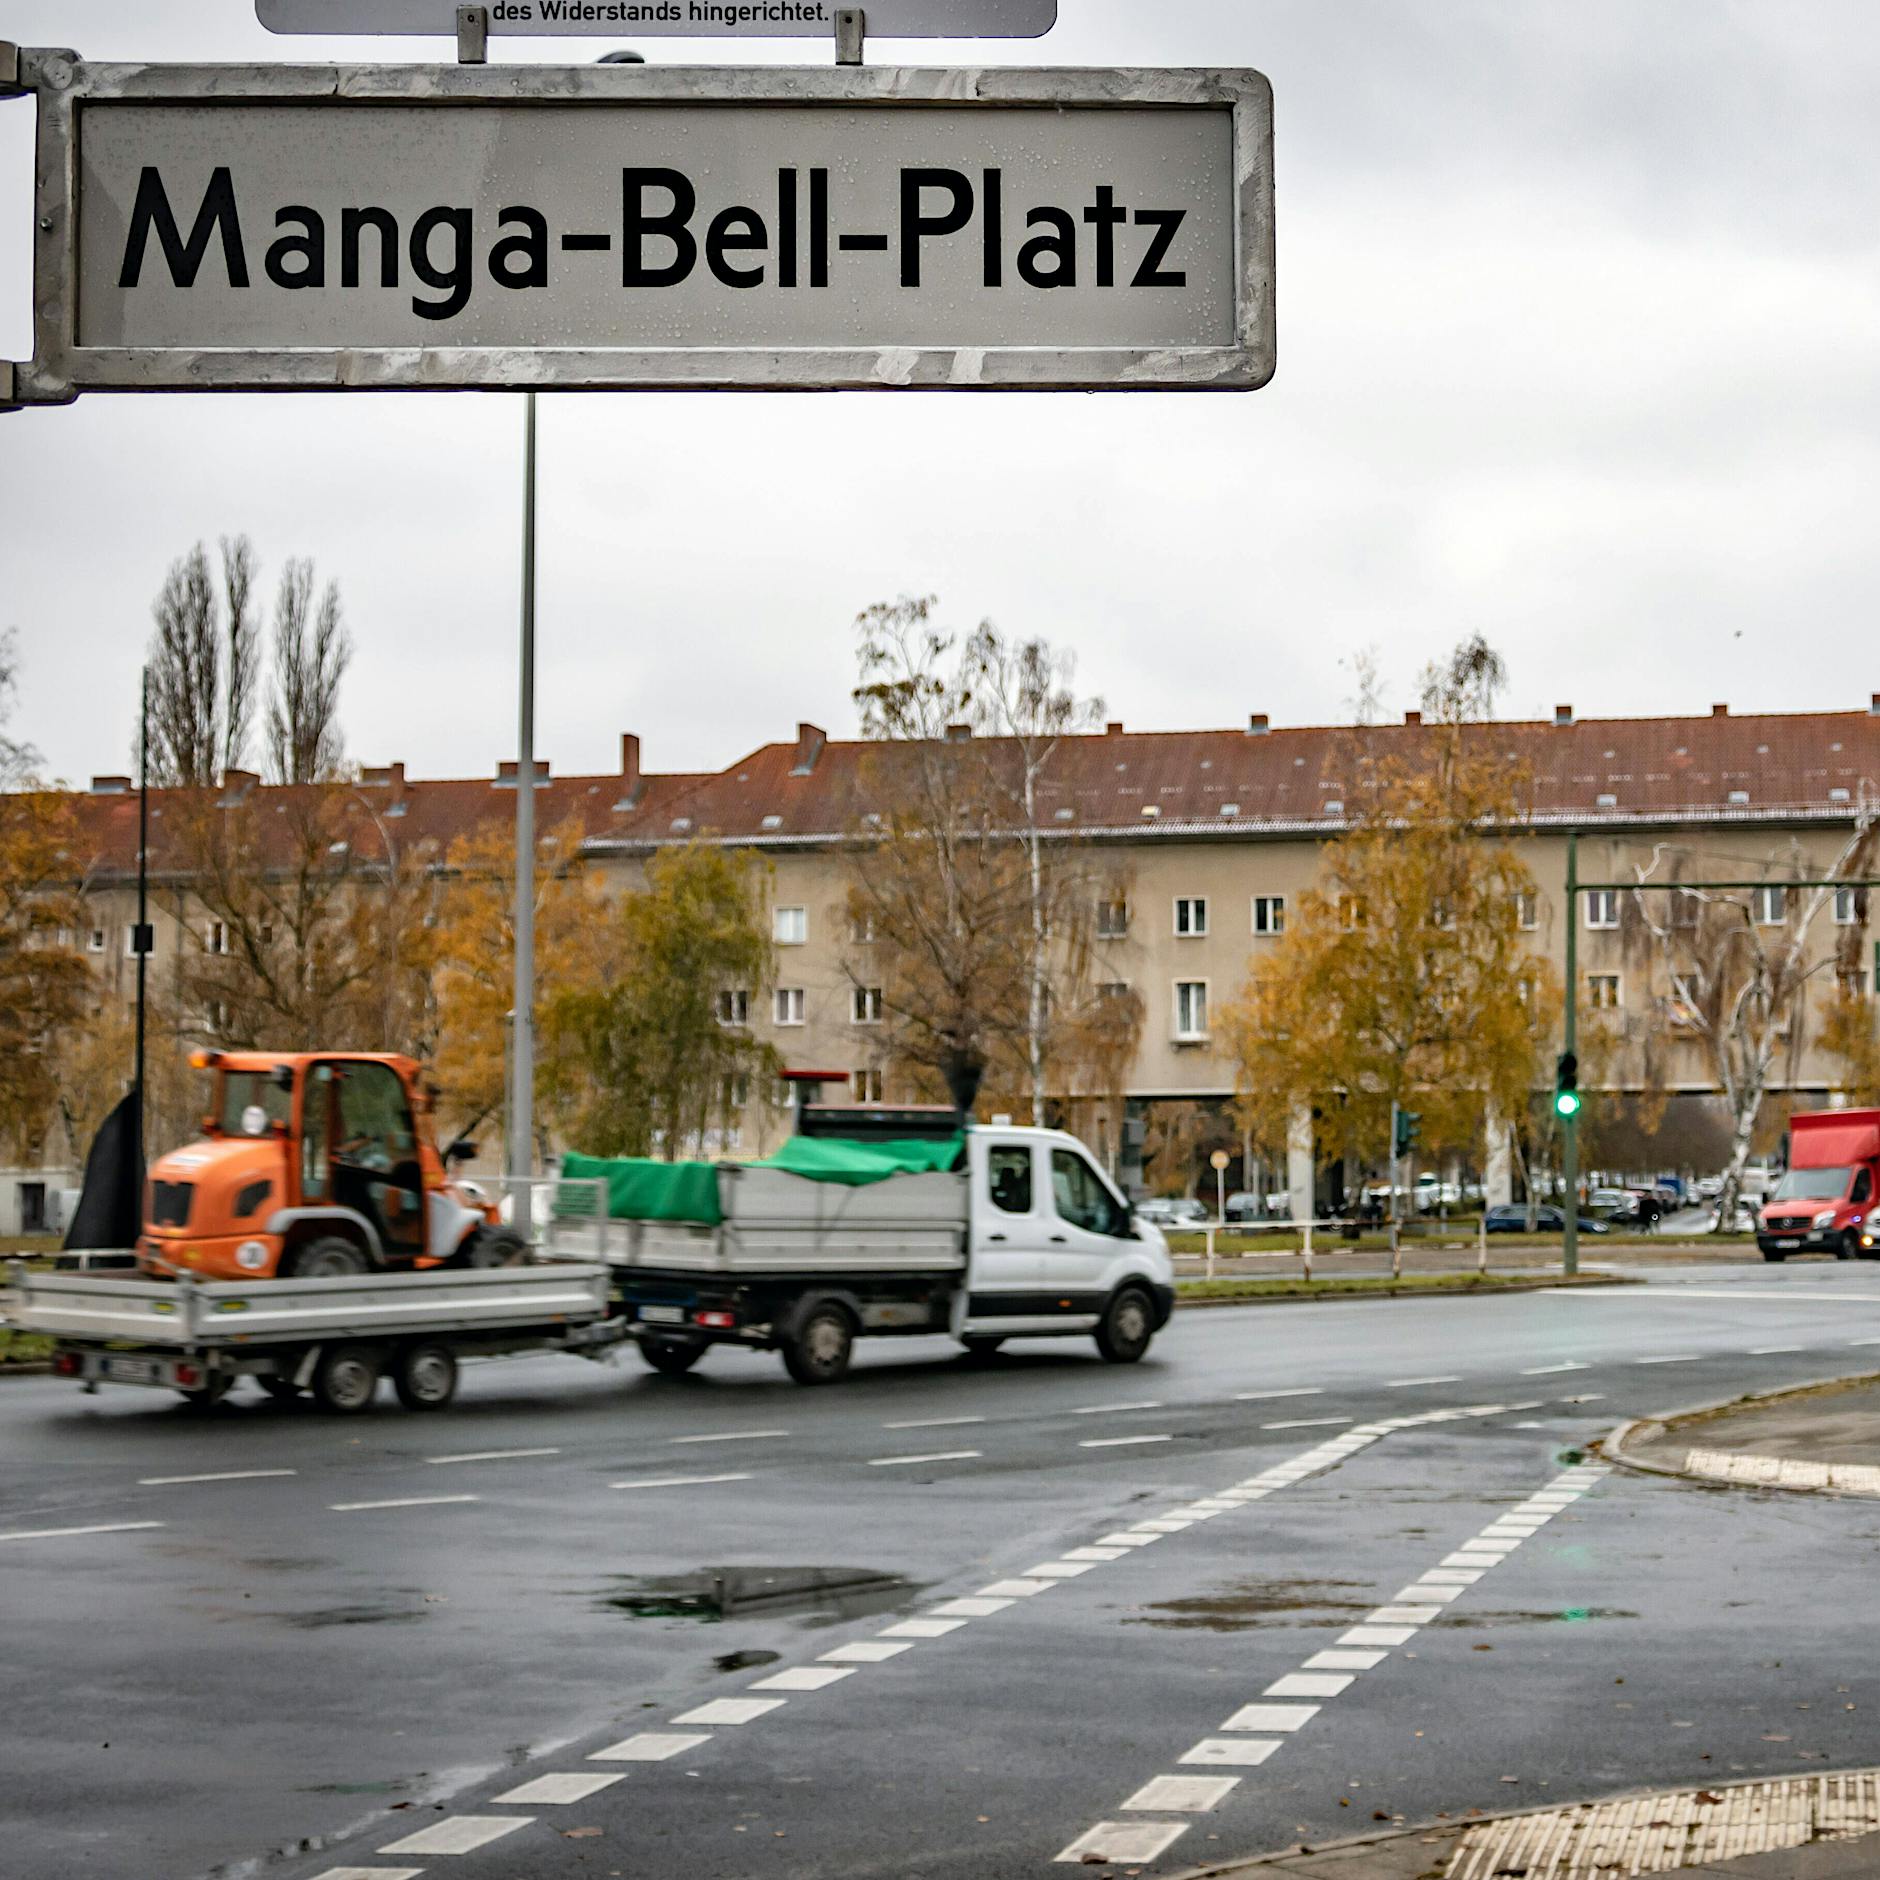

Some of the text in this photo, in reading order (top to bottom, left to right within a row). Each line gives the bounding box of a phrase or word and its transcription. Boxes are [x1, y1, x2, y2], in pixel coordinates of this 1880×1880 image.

[492, 0, 829, 26] des Widerstands hingerichtet.
[117, 166, 1188, 321] Manga-Bell-Platz
